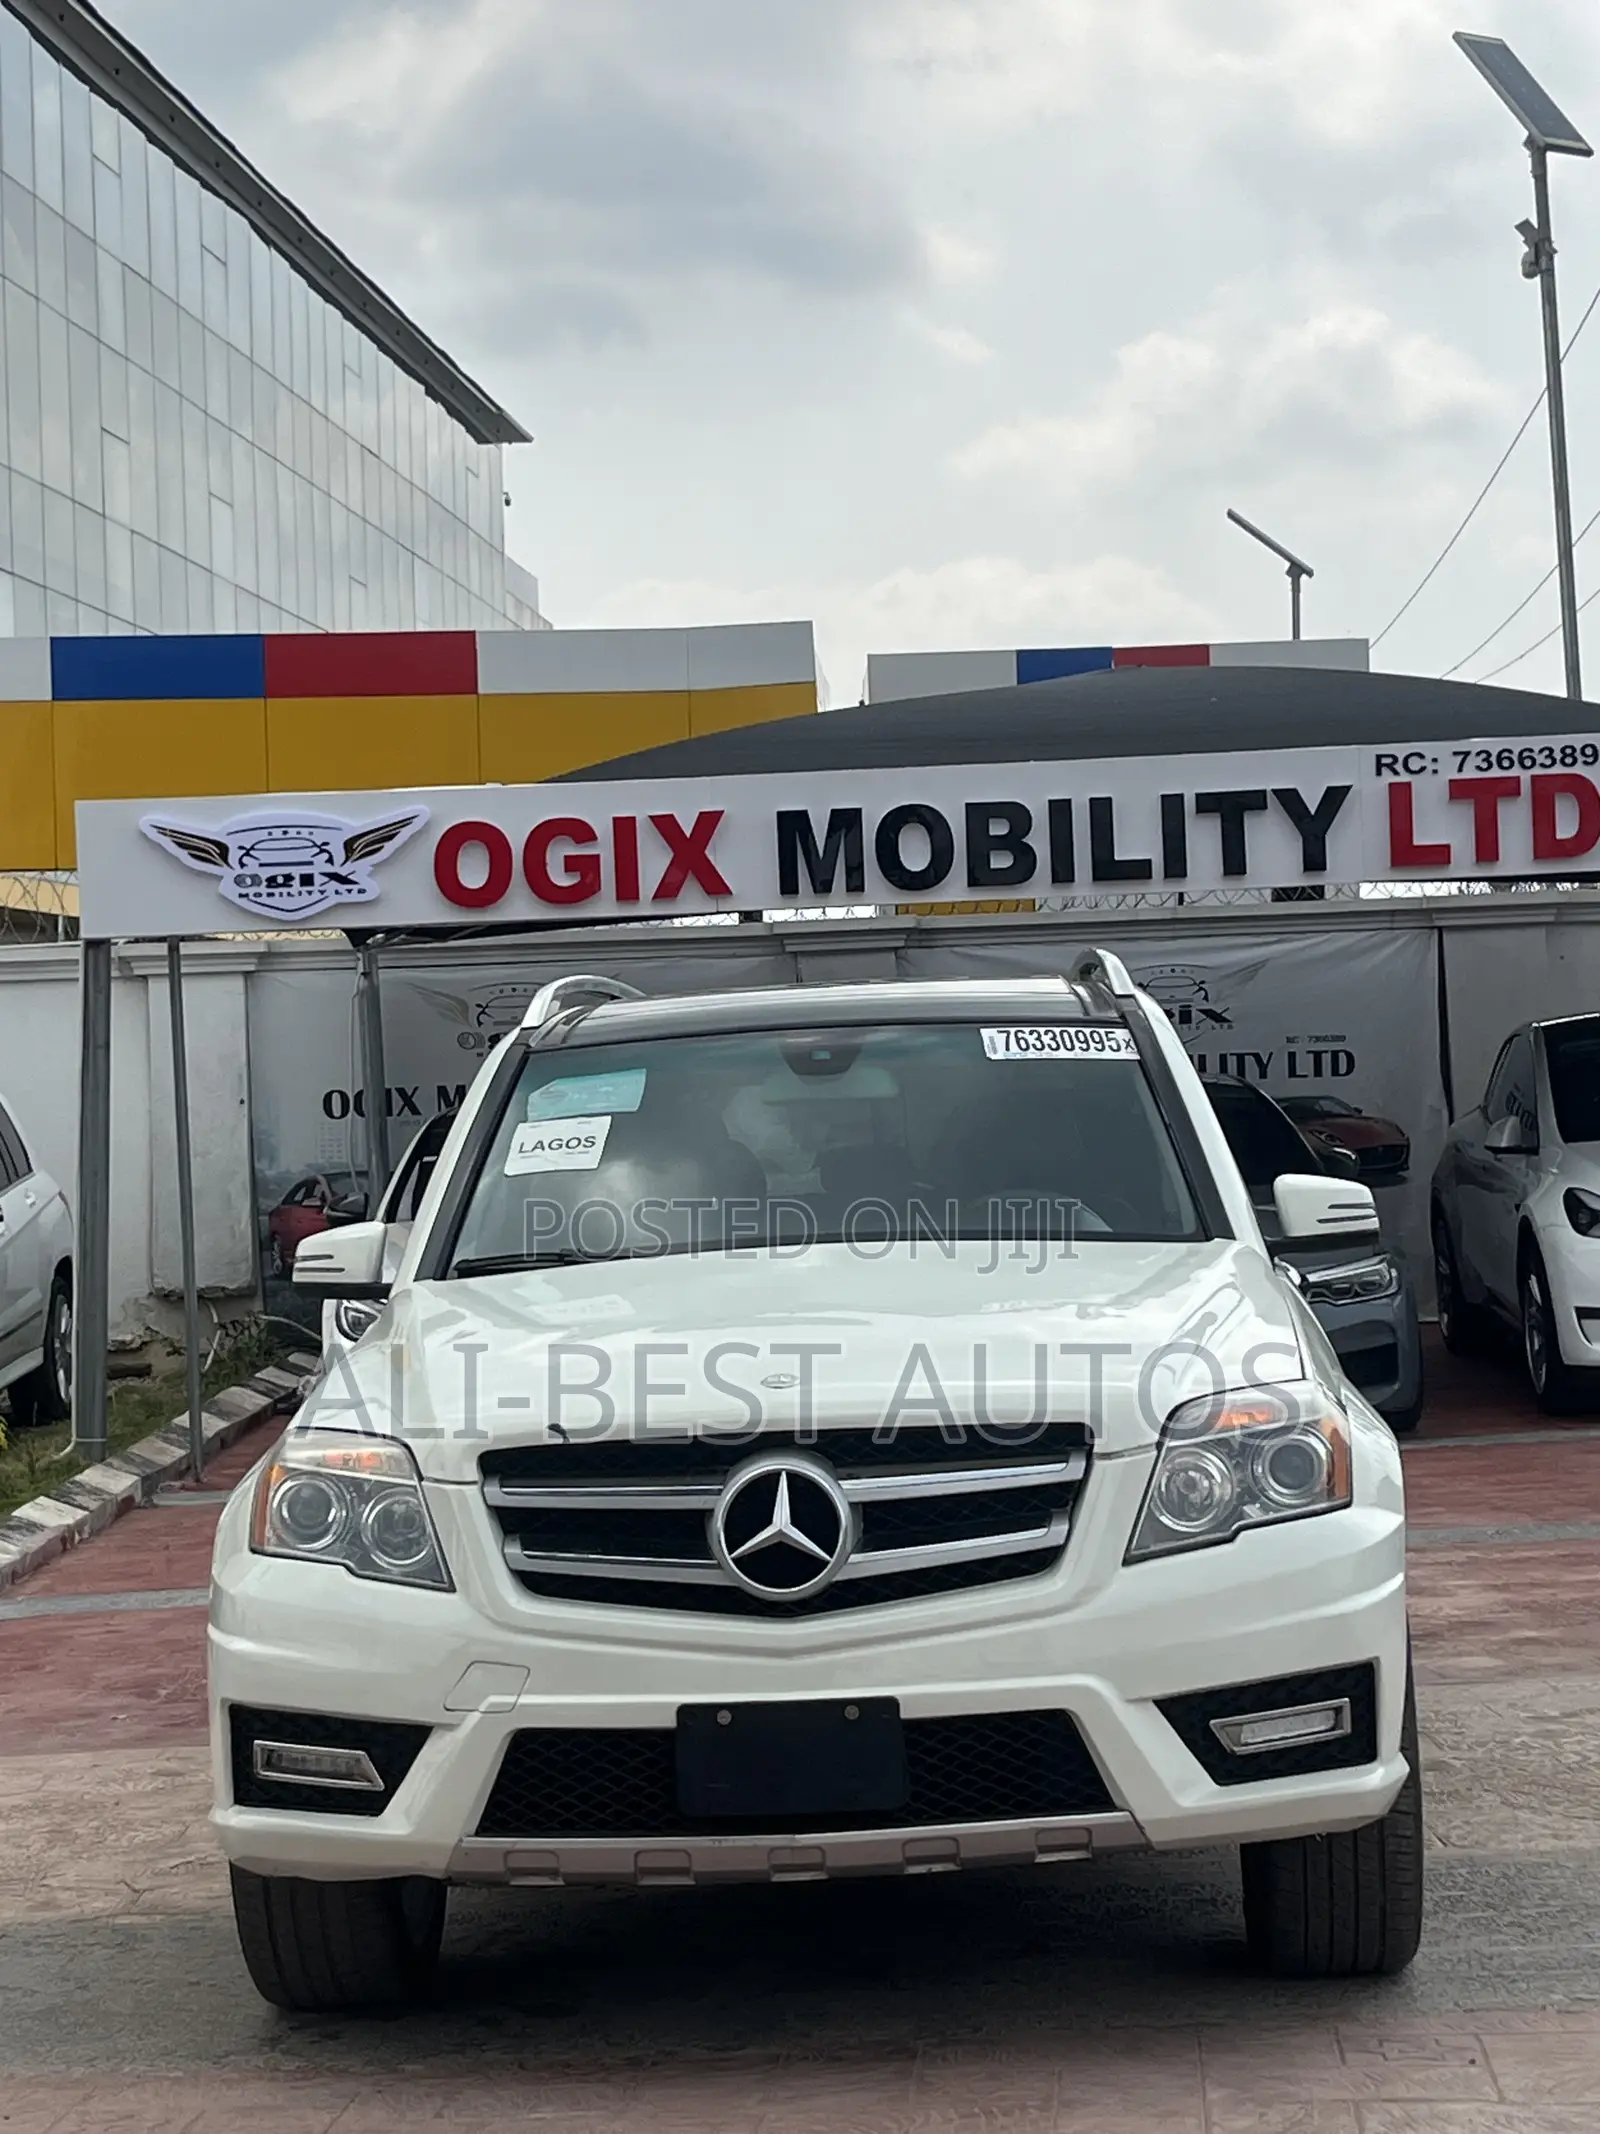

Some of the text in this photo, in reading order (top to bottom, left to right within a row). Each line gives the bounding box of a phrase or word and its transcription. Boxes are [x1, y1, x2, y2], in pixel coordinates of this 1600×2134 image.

[1375, 743, 1599, 776] RC: 7366389
[434, 773, 1600, 908] OGIX MOBILITY LTD
[238, 887, 368, 899] MOBILITY LTD
[1287, 1049, 1356, 1079] LTD
[518, 1135, 597, 1154] LAGOS
